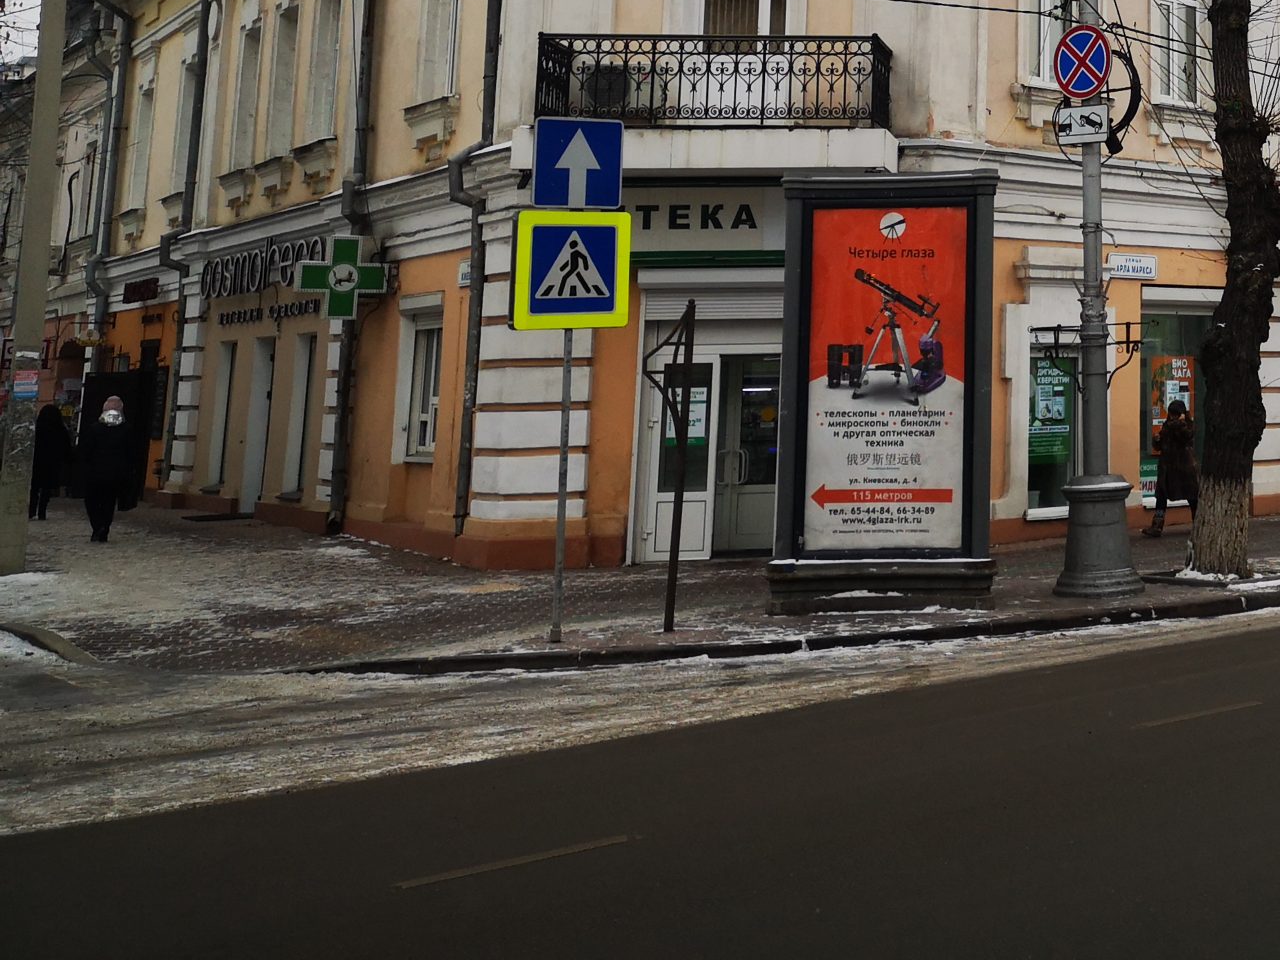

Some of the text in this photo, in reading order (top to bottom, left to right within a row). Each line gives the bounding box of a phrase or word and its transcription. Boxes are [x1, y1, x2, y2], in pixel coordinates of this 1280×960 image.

[600, 203, 758, 230] ТЕКА
[848, 246, 935, 261] Четыре глаза
[1171, 358, 1188, 368] БИО
[1172, 369, 1191, 378] ЧАГА
[824, 410, 945, 419] телескопы планетарии
[827, 419, 941, 428] микроскопы бинокли
[842, 430, 876, 439] другая
[846, 452, 922, 466] 俄罗斯望远镜
[863, 477, 900, 485] Киевская,
[852, 491, 913, 501] 115 метров
[896, 506, 935, 515] 66-34-89
[842, 516, 922, 525] www.4glaza-irk.ru
